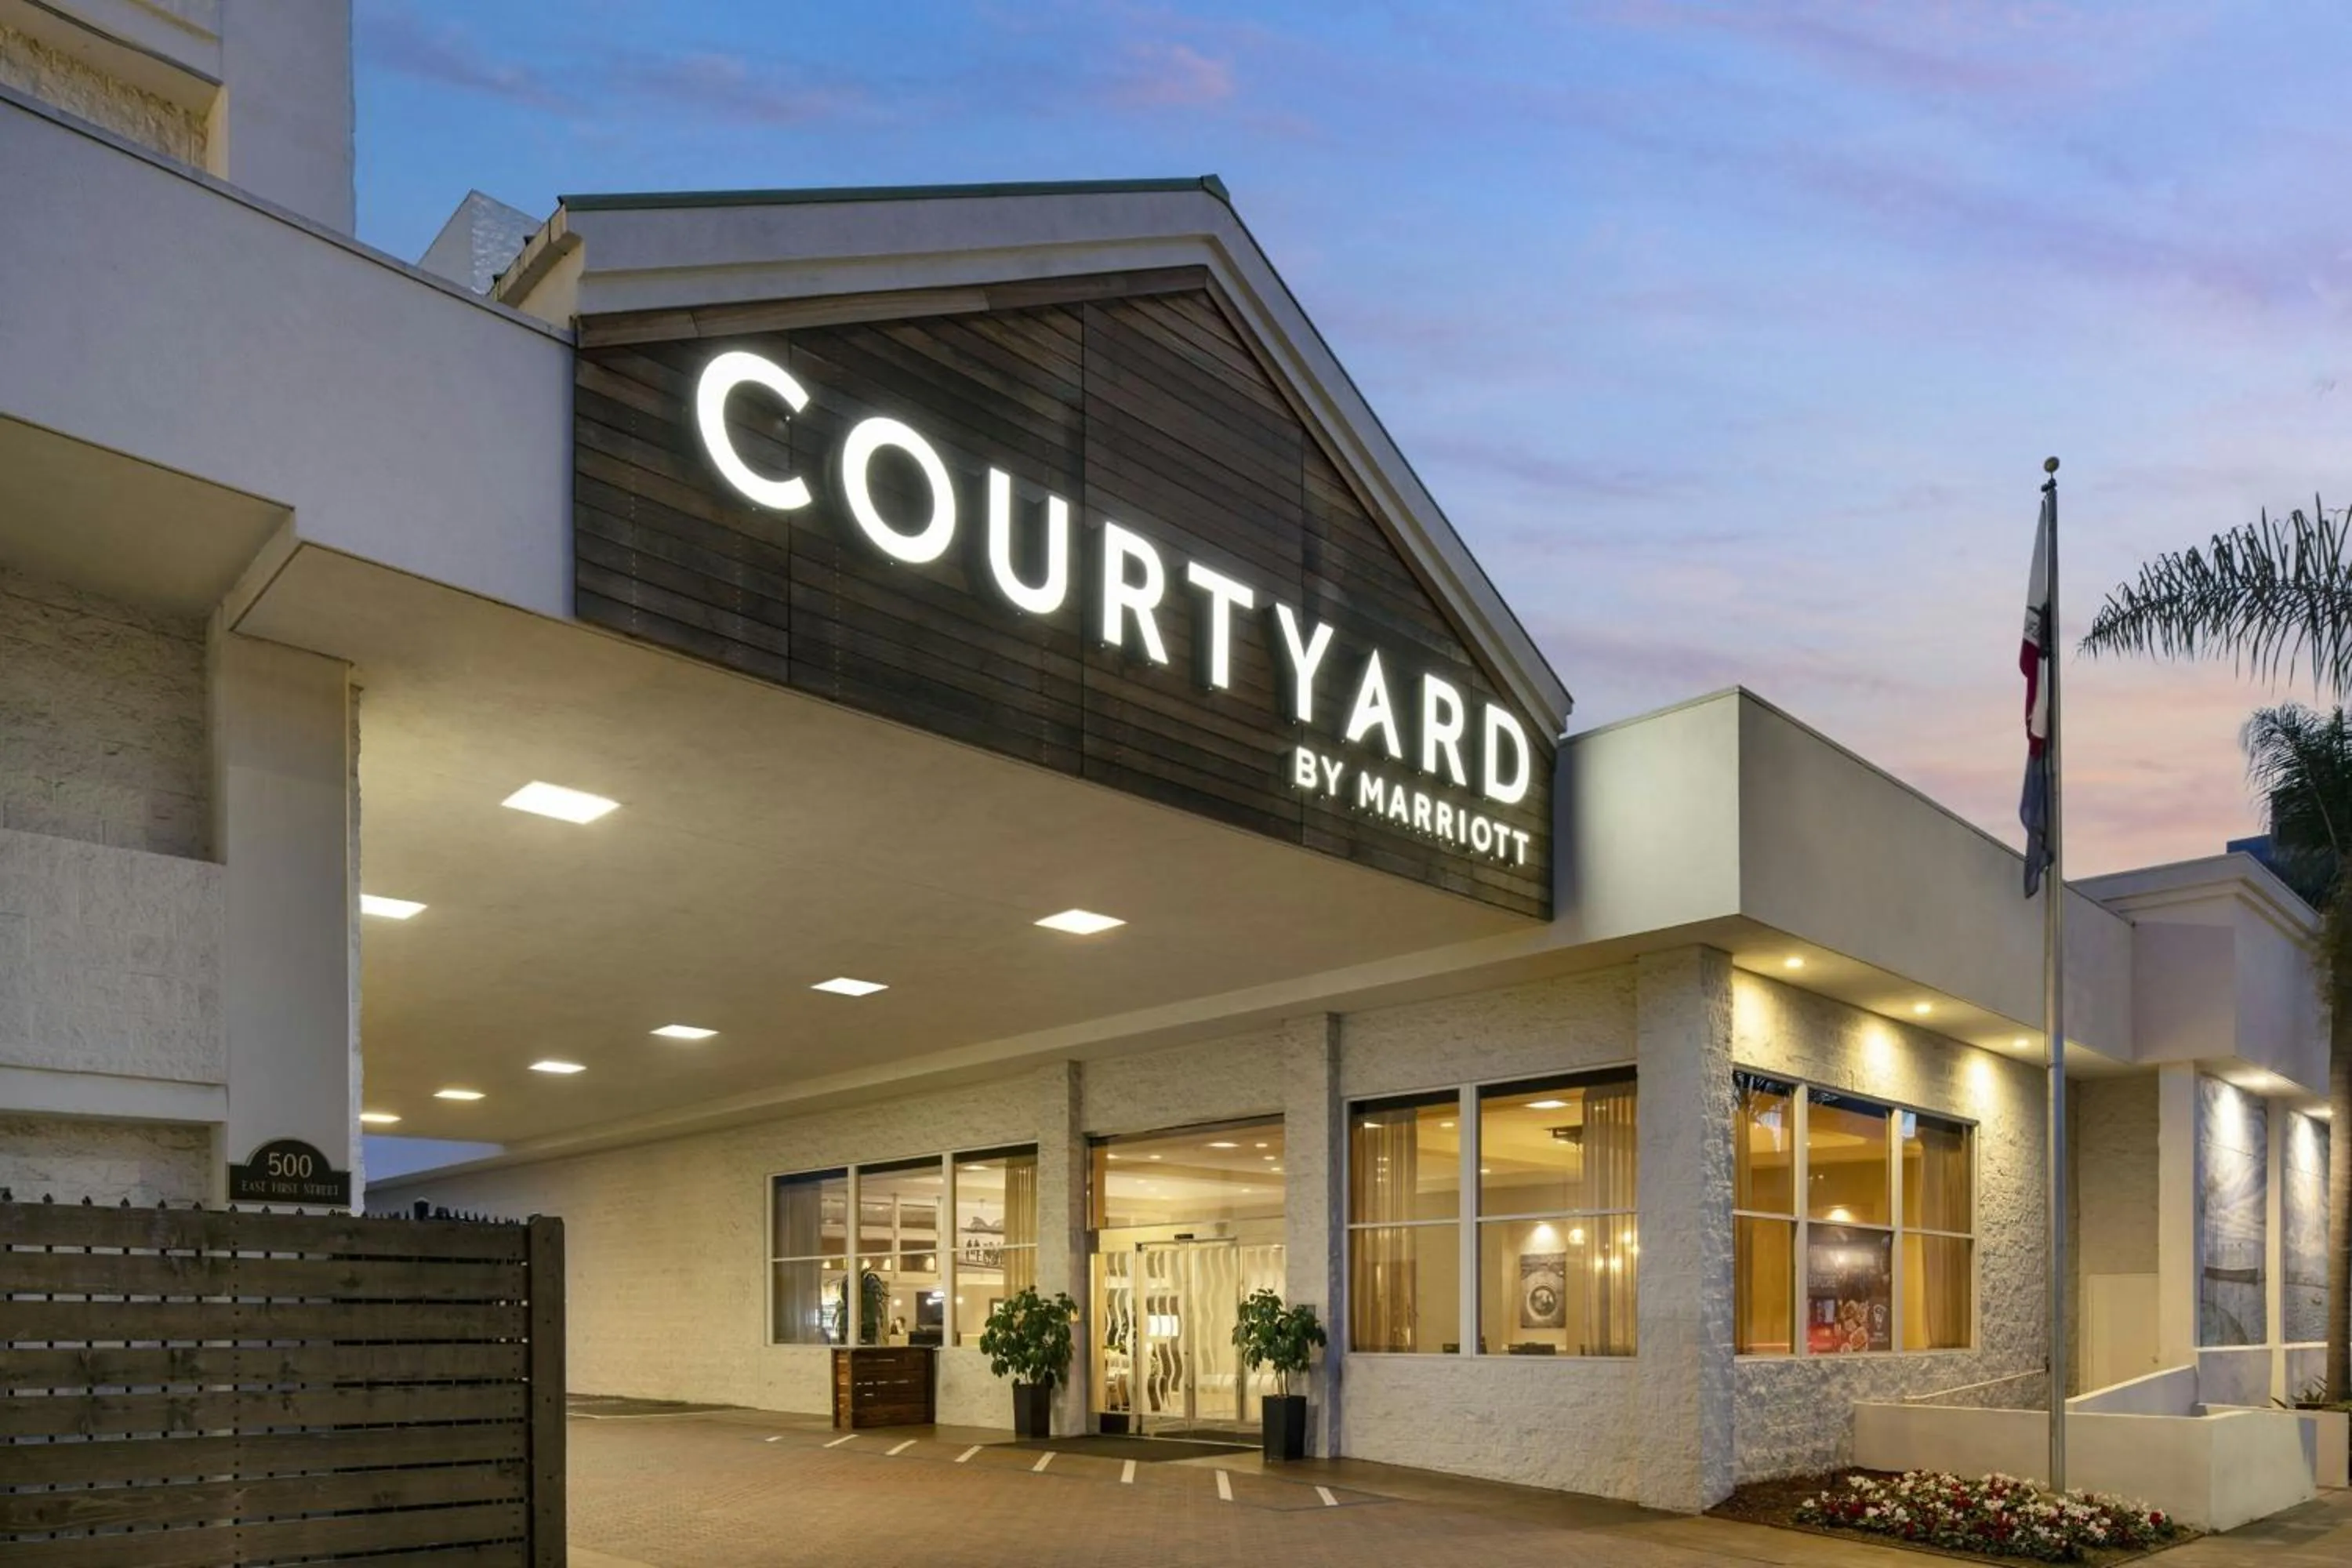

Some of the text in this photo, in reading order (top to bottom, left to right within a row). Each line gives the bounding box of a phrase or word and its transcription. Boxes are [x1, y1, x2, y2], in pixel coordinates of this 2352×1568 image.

[695, 350, 1531, 806] COURTYARD
[1294, 746, 1530, 866] BY MARRIOTT
[241, 1179, 266, 1192] EAST
[303, 1182, 339, 1196] STREET
[268, 1152, 313, 1178] 500
